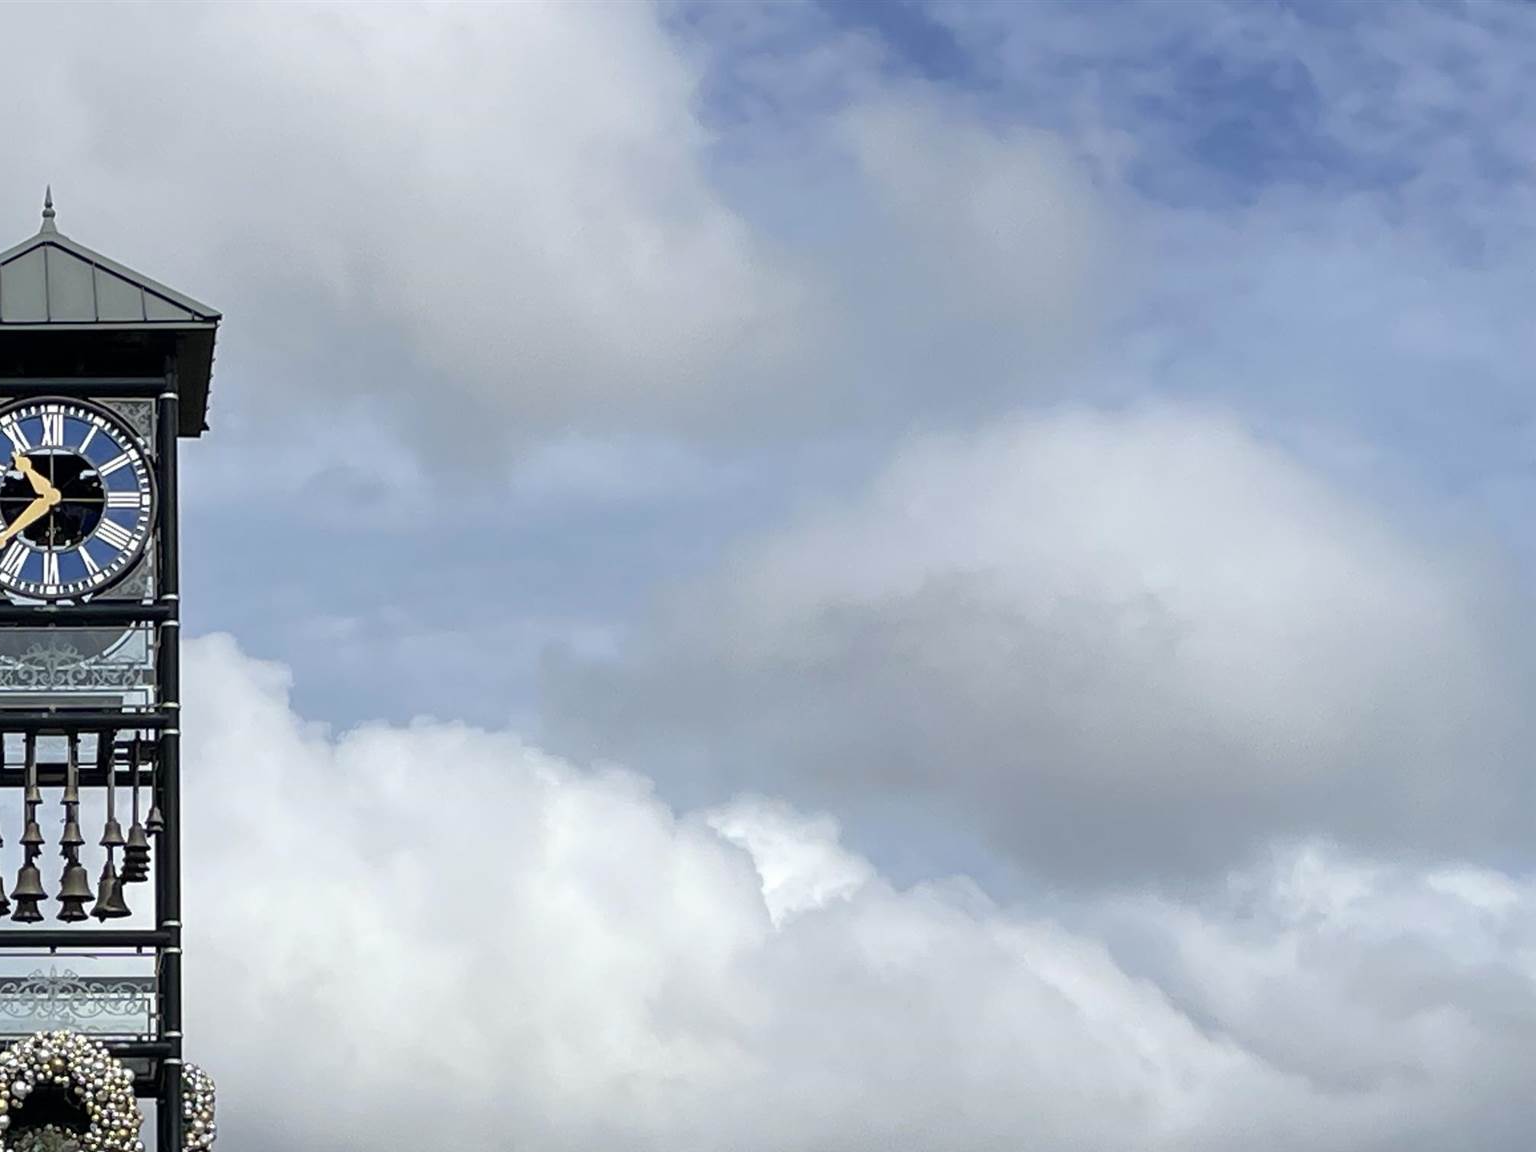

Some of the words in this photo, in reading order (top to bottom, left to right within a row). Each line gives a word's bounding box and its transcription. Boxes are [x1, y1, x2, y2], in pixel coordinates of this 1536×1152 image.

[2, 422, 32, 455] XI
[41, 414, 64, 446] XII
[98, 452, 131, 477] II
[107, 491, 141, 508] III
